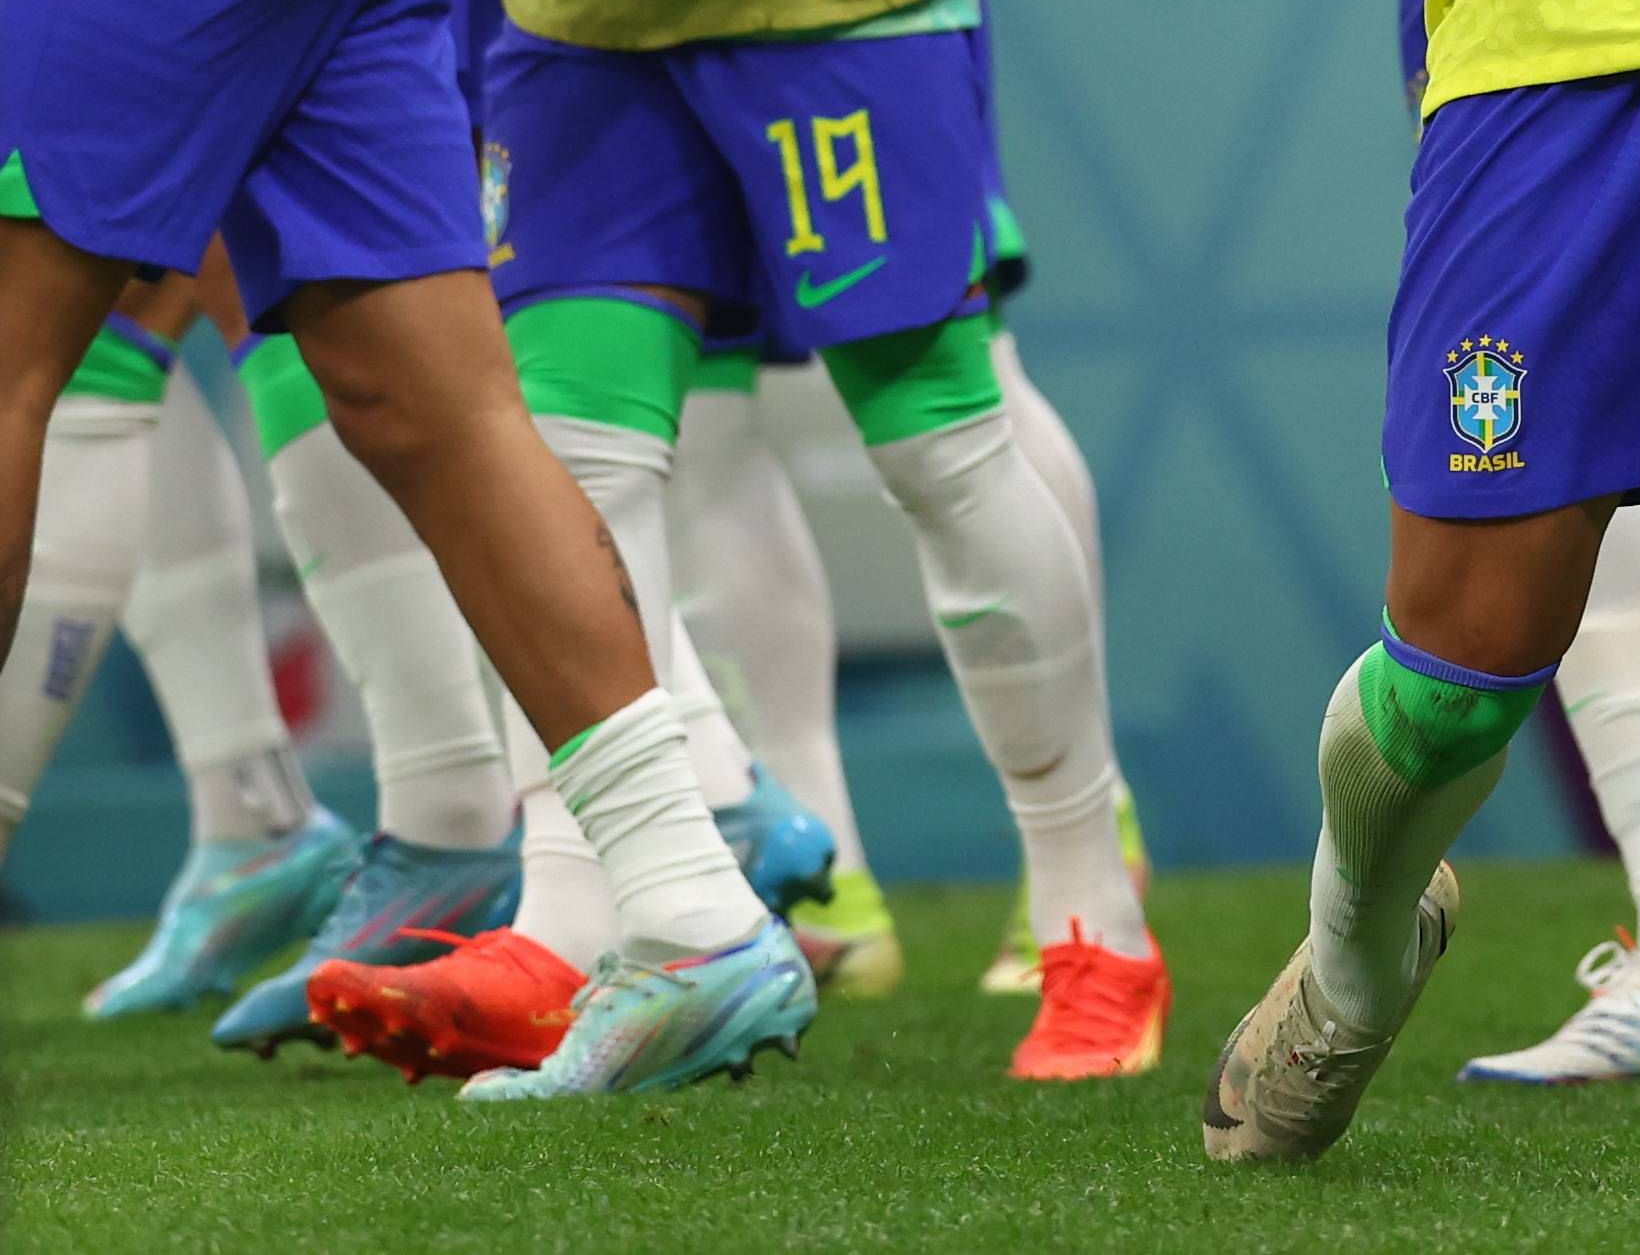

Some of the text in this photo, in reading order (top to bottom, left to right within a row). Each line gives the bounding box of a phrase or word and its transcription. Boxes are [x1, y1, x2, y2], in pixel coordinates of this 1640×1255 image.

[766, 108, 887, 259] 19
[1471, 392, 1499, 404] CBF
[1449, 451, 1525, 473] BRASIL
